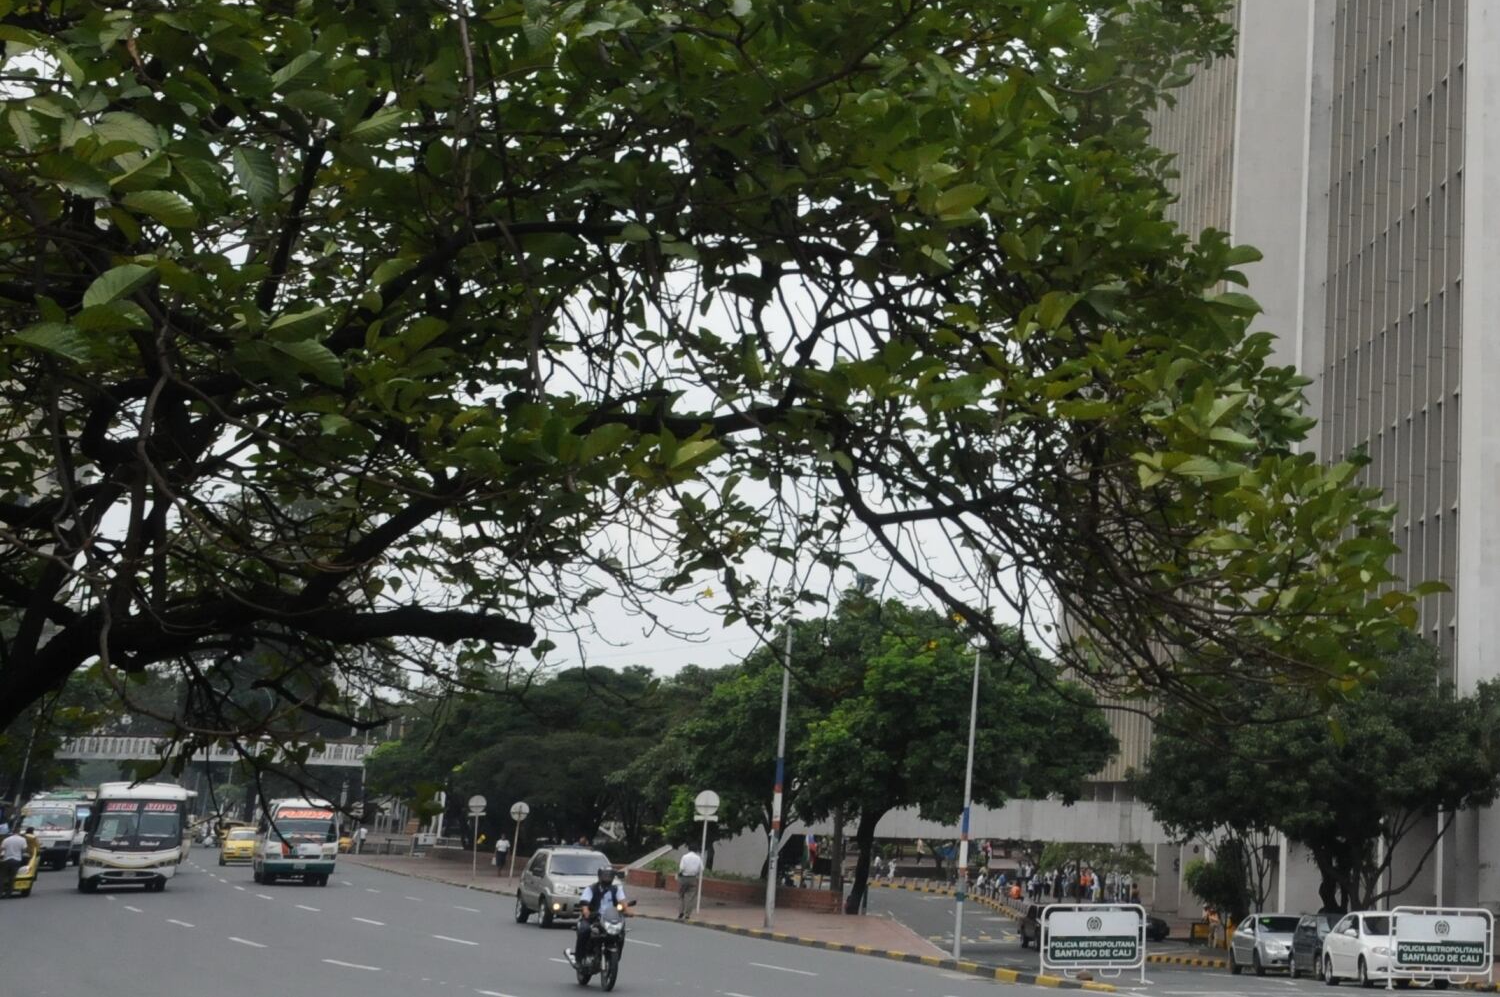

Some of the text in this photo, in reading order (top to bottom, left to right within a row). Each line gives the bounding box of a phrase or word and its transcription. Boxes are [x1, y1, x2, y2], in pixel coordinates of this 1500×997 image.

[1051, 941, 1135, 949] POLICIA METROPOLITANA
[1055, 948, 1132, 957] SANTIAGO DE CALI
[1402, 953, 1445, 962] SANTIAGO
